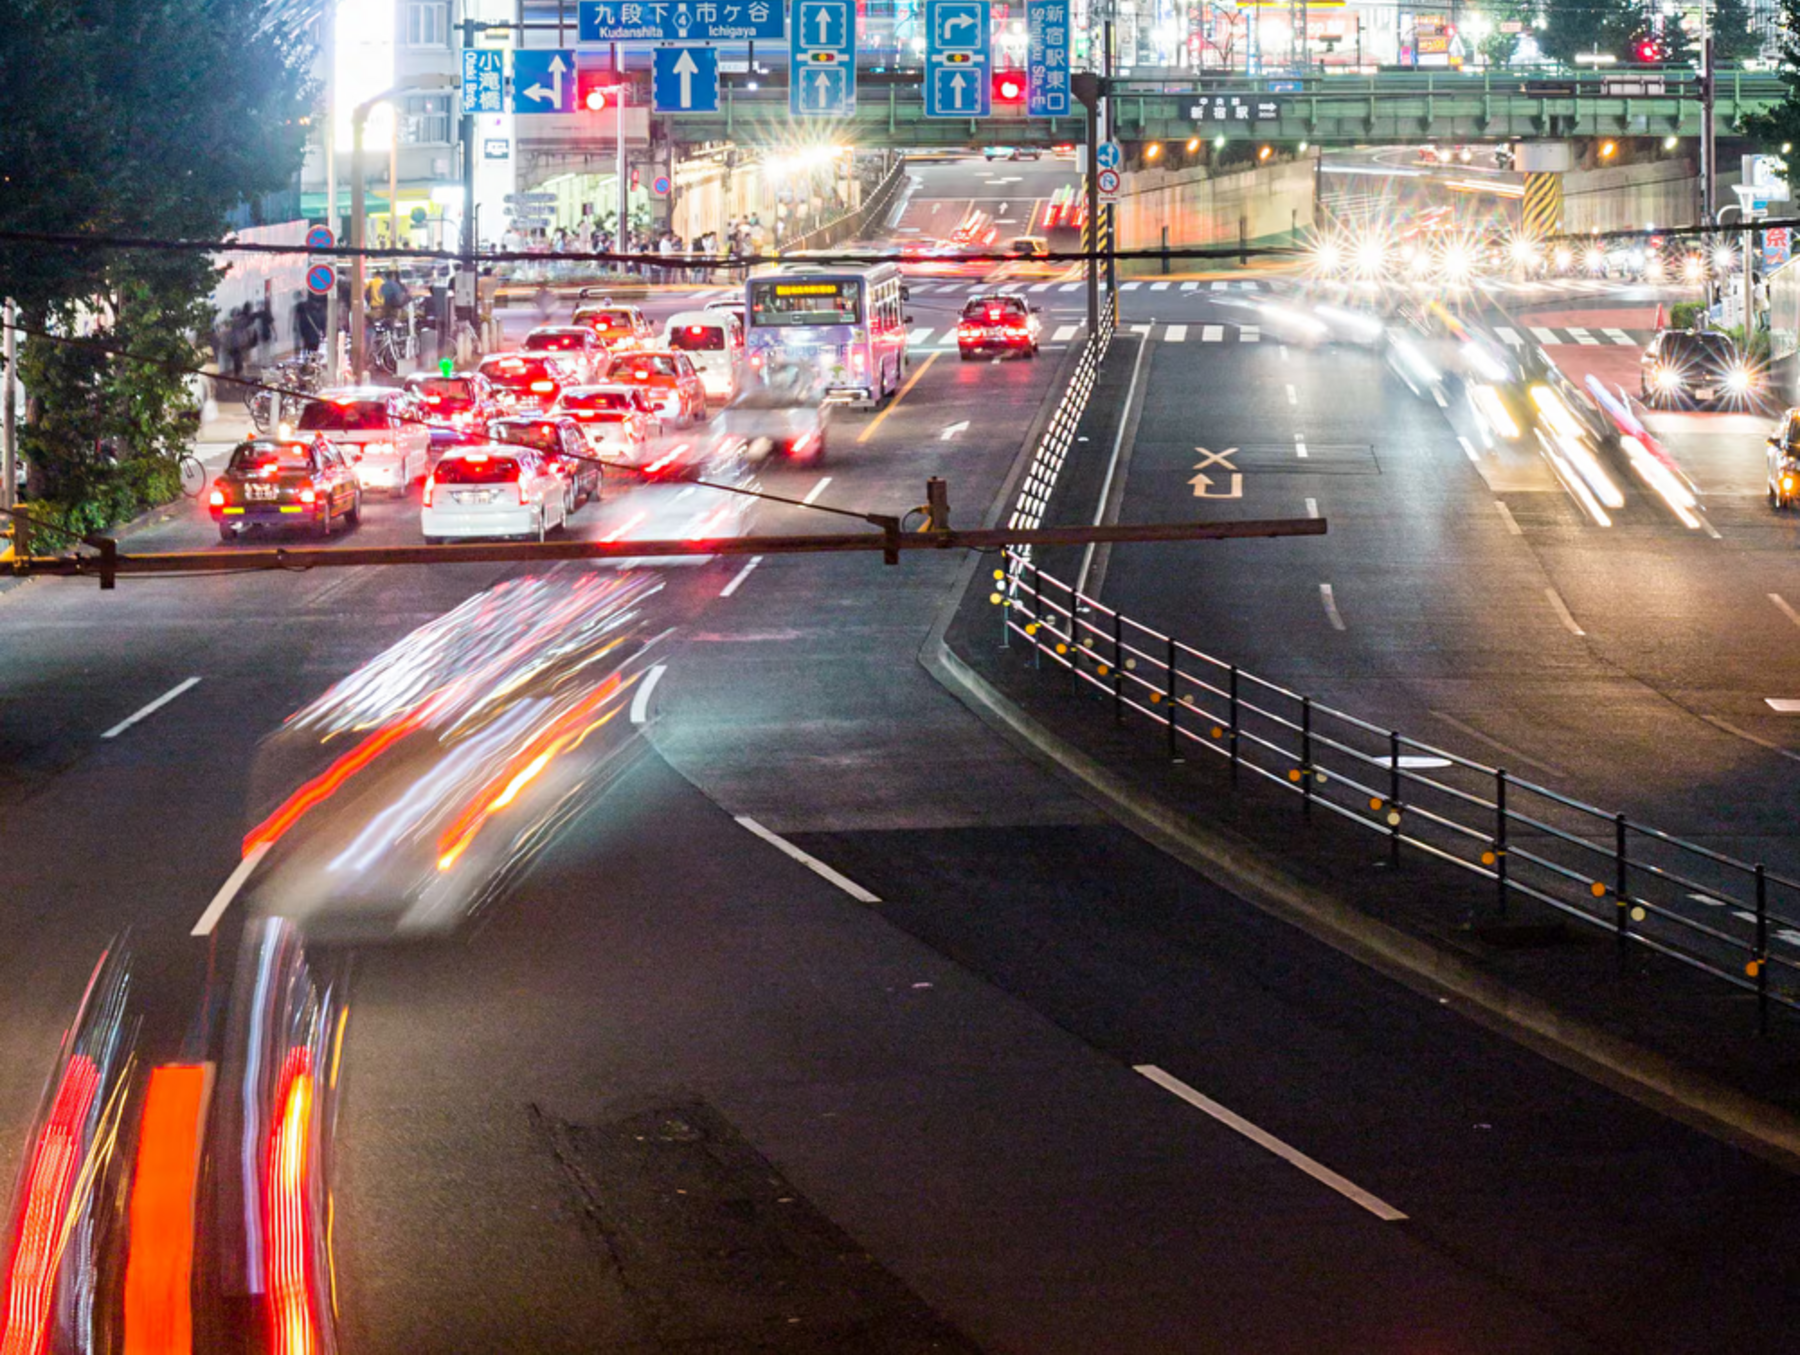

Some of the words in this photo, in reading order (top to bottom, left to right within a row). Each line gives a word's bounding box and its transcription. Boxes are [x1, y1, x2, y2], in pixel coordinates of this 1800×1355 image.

[594, 3, 669, 25] 九段下
[599, 26, 663, 39] Kudanshita
[708, 25, 757, 40] Ichigaya
[1031, 6, 1046, 62] Shinjuku
[1045, 4, 1066, 111] 新宿駅東口
